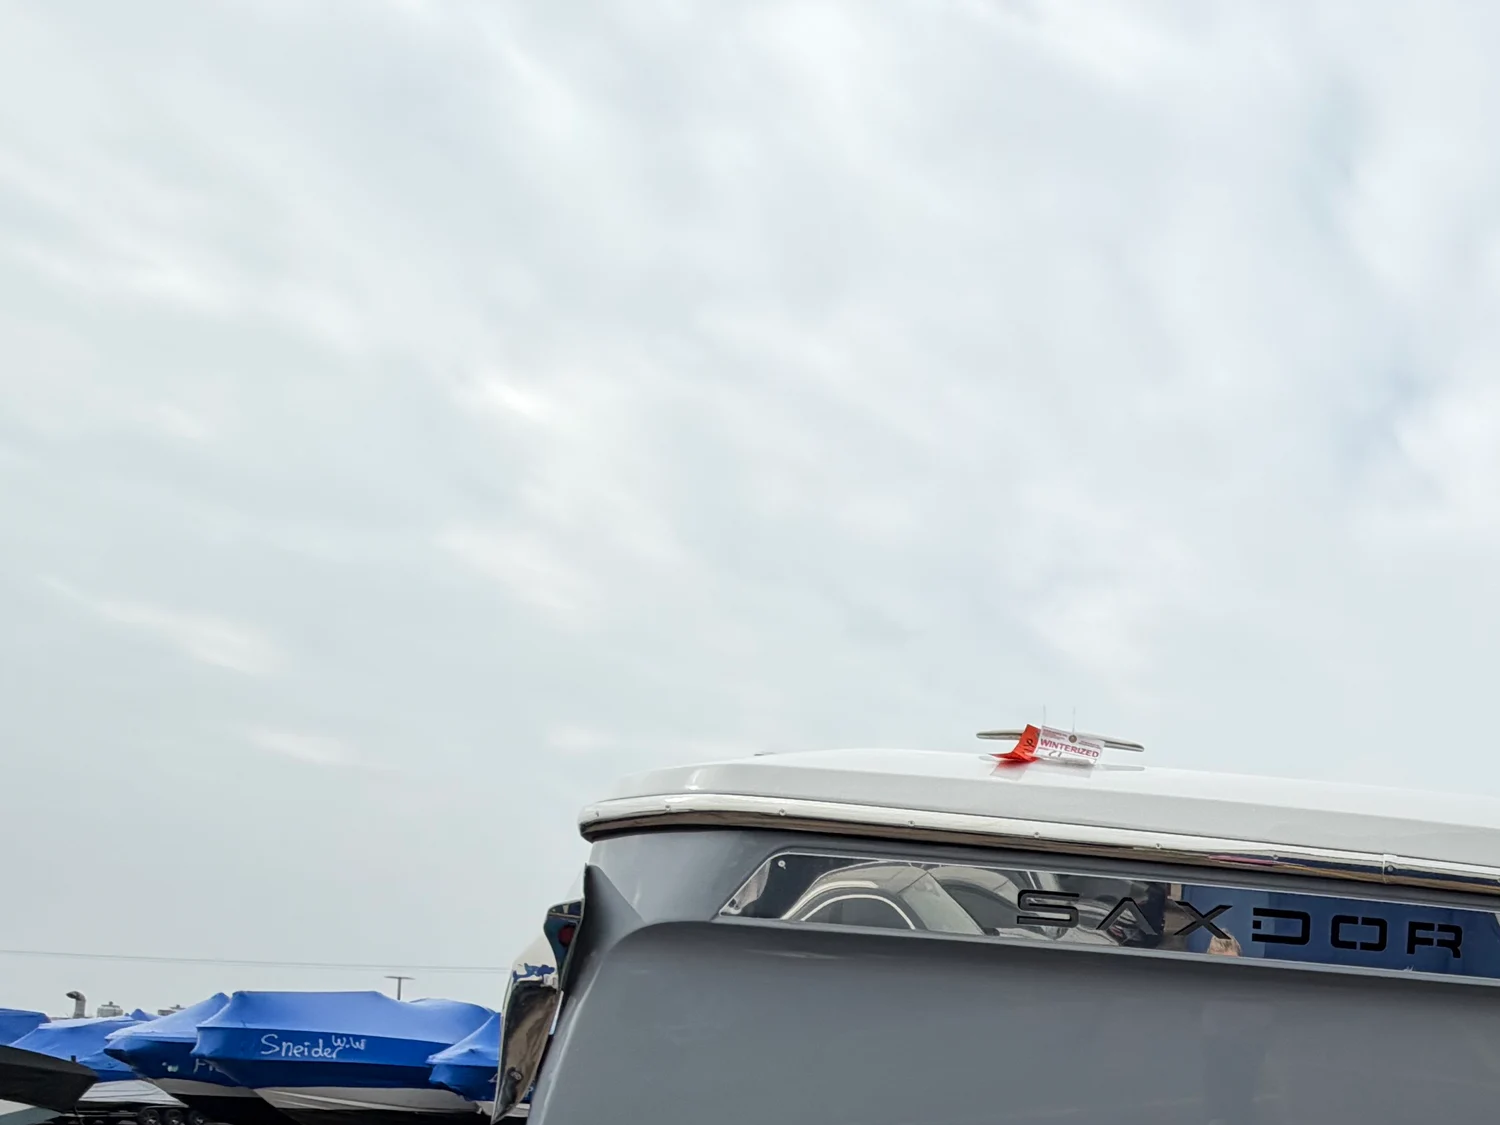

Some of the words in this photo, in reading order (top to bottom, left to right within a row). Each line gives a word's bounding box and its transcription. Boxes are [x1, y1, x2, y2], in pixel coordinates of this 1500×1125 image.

[1040, 739, 1099, 757] WINTERIZED
[1016, 889, 1463, 959] SAXDOR
[261, 1034, 343, 1059] Sneider
